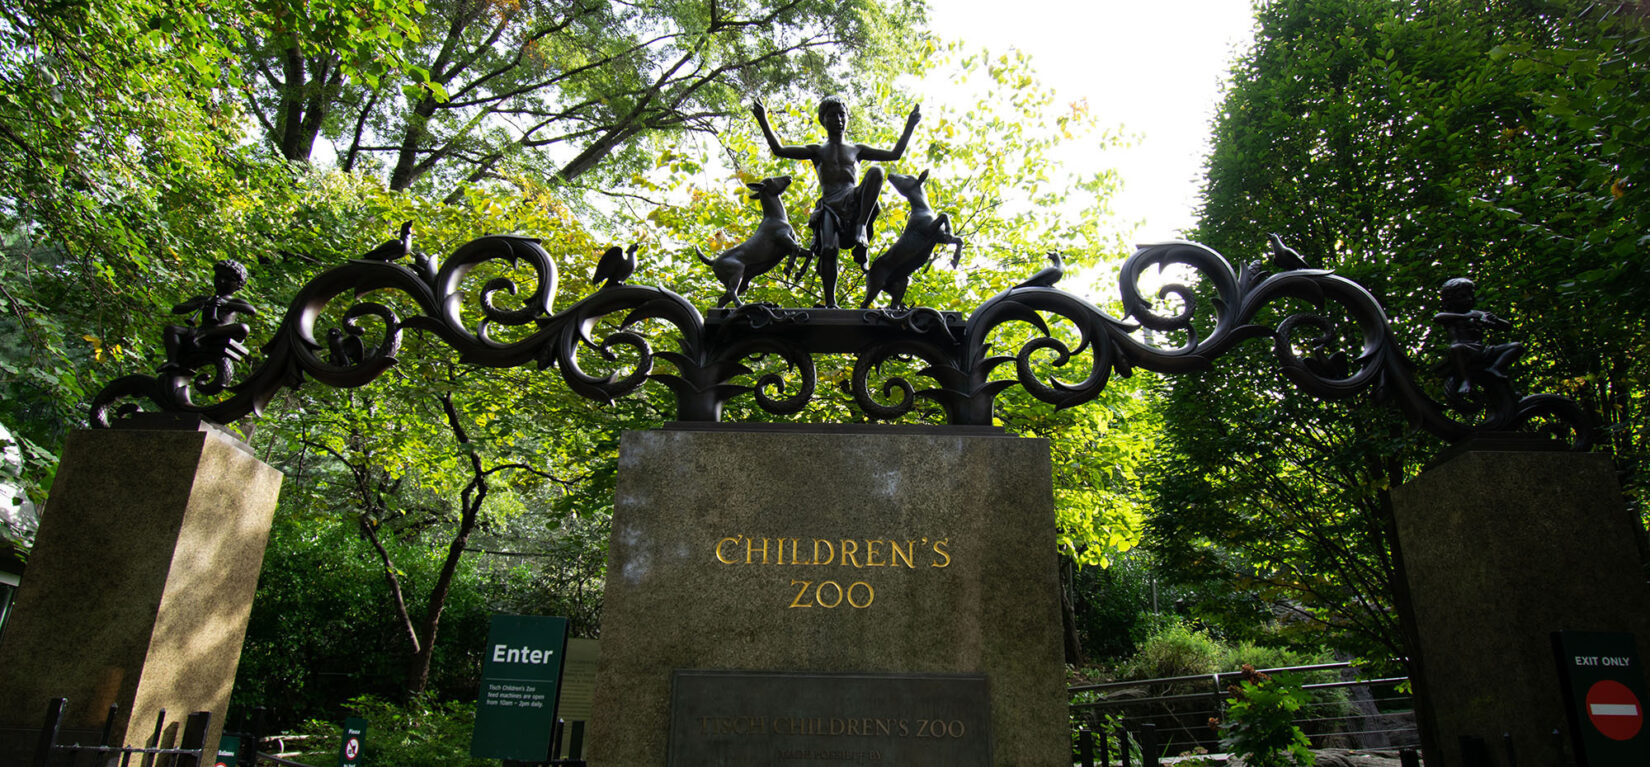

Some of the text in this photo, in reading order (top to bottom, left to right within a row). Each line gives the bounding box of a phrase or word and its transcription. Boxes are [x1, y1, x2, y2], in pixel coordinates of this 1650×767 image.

[715, 534, 952, 568] CHILDREN'S
[789, 579, 875, 609] ZOO
[492, 644, 554, 664] Enter
[1574, 655, 1631, 667] EXIT ONLY
[699, 715, 967, 738] TISCH CHILDREN'S ZOO
